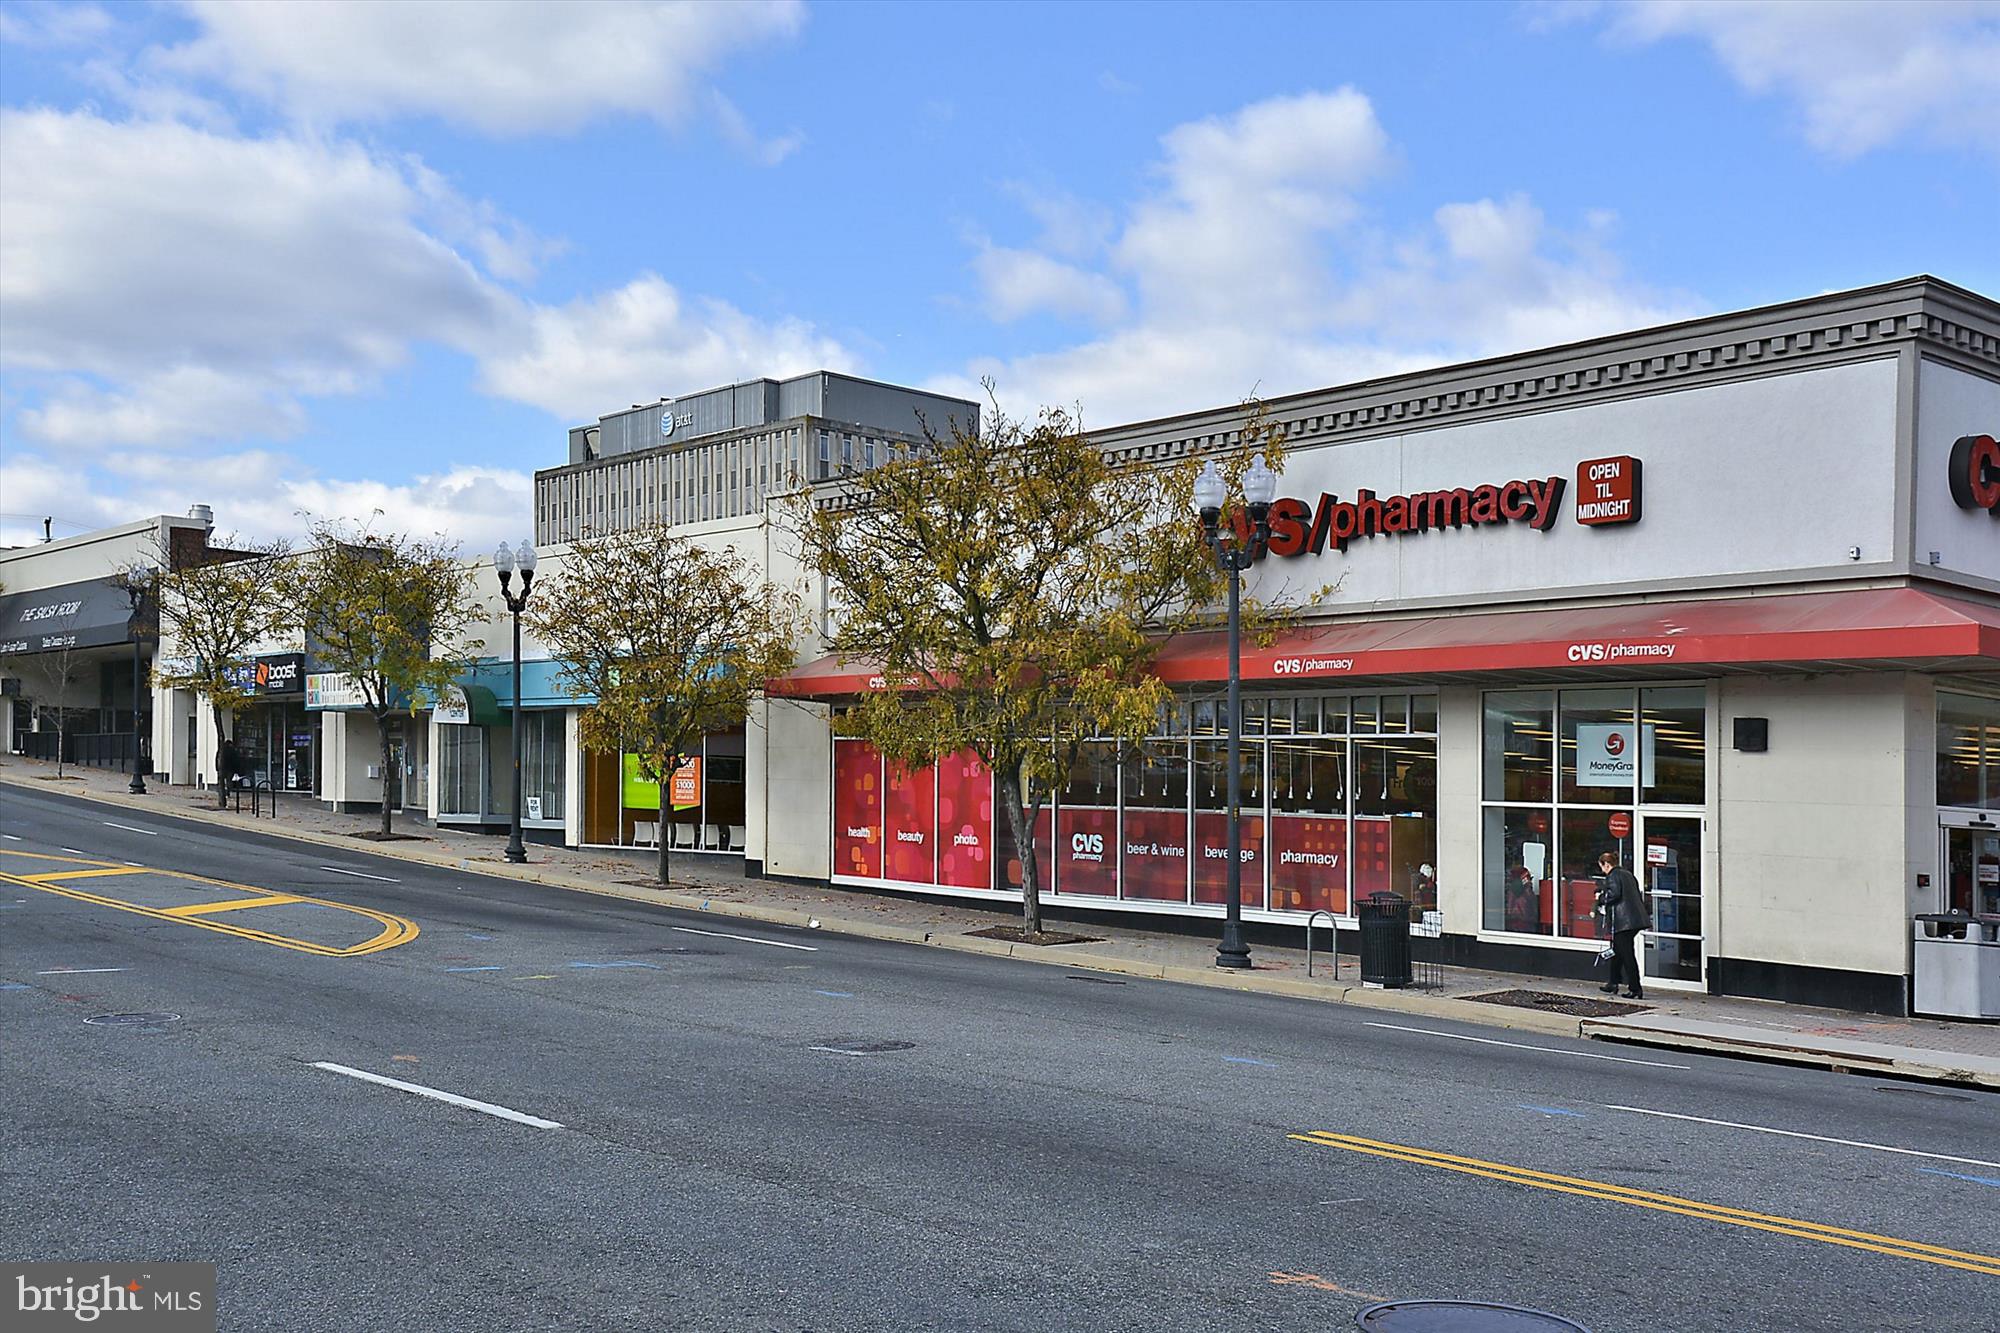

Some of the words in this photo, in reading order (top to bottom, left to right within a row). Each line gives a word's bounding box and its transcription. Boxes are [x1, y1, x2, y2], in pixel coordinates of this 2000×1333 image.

[1589, 462, 1620, 480] OPEN
[1595, 483, 1613, 499] TIL
[1199, 475, 1567, 561] VS/pharmacy
[1577, 499, 1631, 521] MIDNIGHT
[1568, 643, 1675, 661] CVS/pharmacy
[269, 661, 297, 680] boost
[1273, 657, 1353, 675] CVS/pharmacy
[1589, 761, 1634, 772] MoneyGra
[675, 779, 695, 790] $1000
[847, 826, 871, 838] health
[897, 829, 924, 845] beauty
[953, 832, 979, 846] photo
[1072, 832, 1103, 853] CVS
[1126, 842, 1149, 856] beer
[1150, 843, 1159, 856] &
[1160, 844, 1185, 857] wine
[1072, 852, 1103, 862] pharmacy
[1204, 845, 1255, 862] bevege
[1280, 850, 1338, 868] pharmacy
